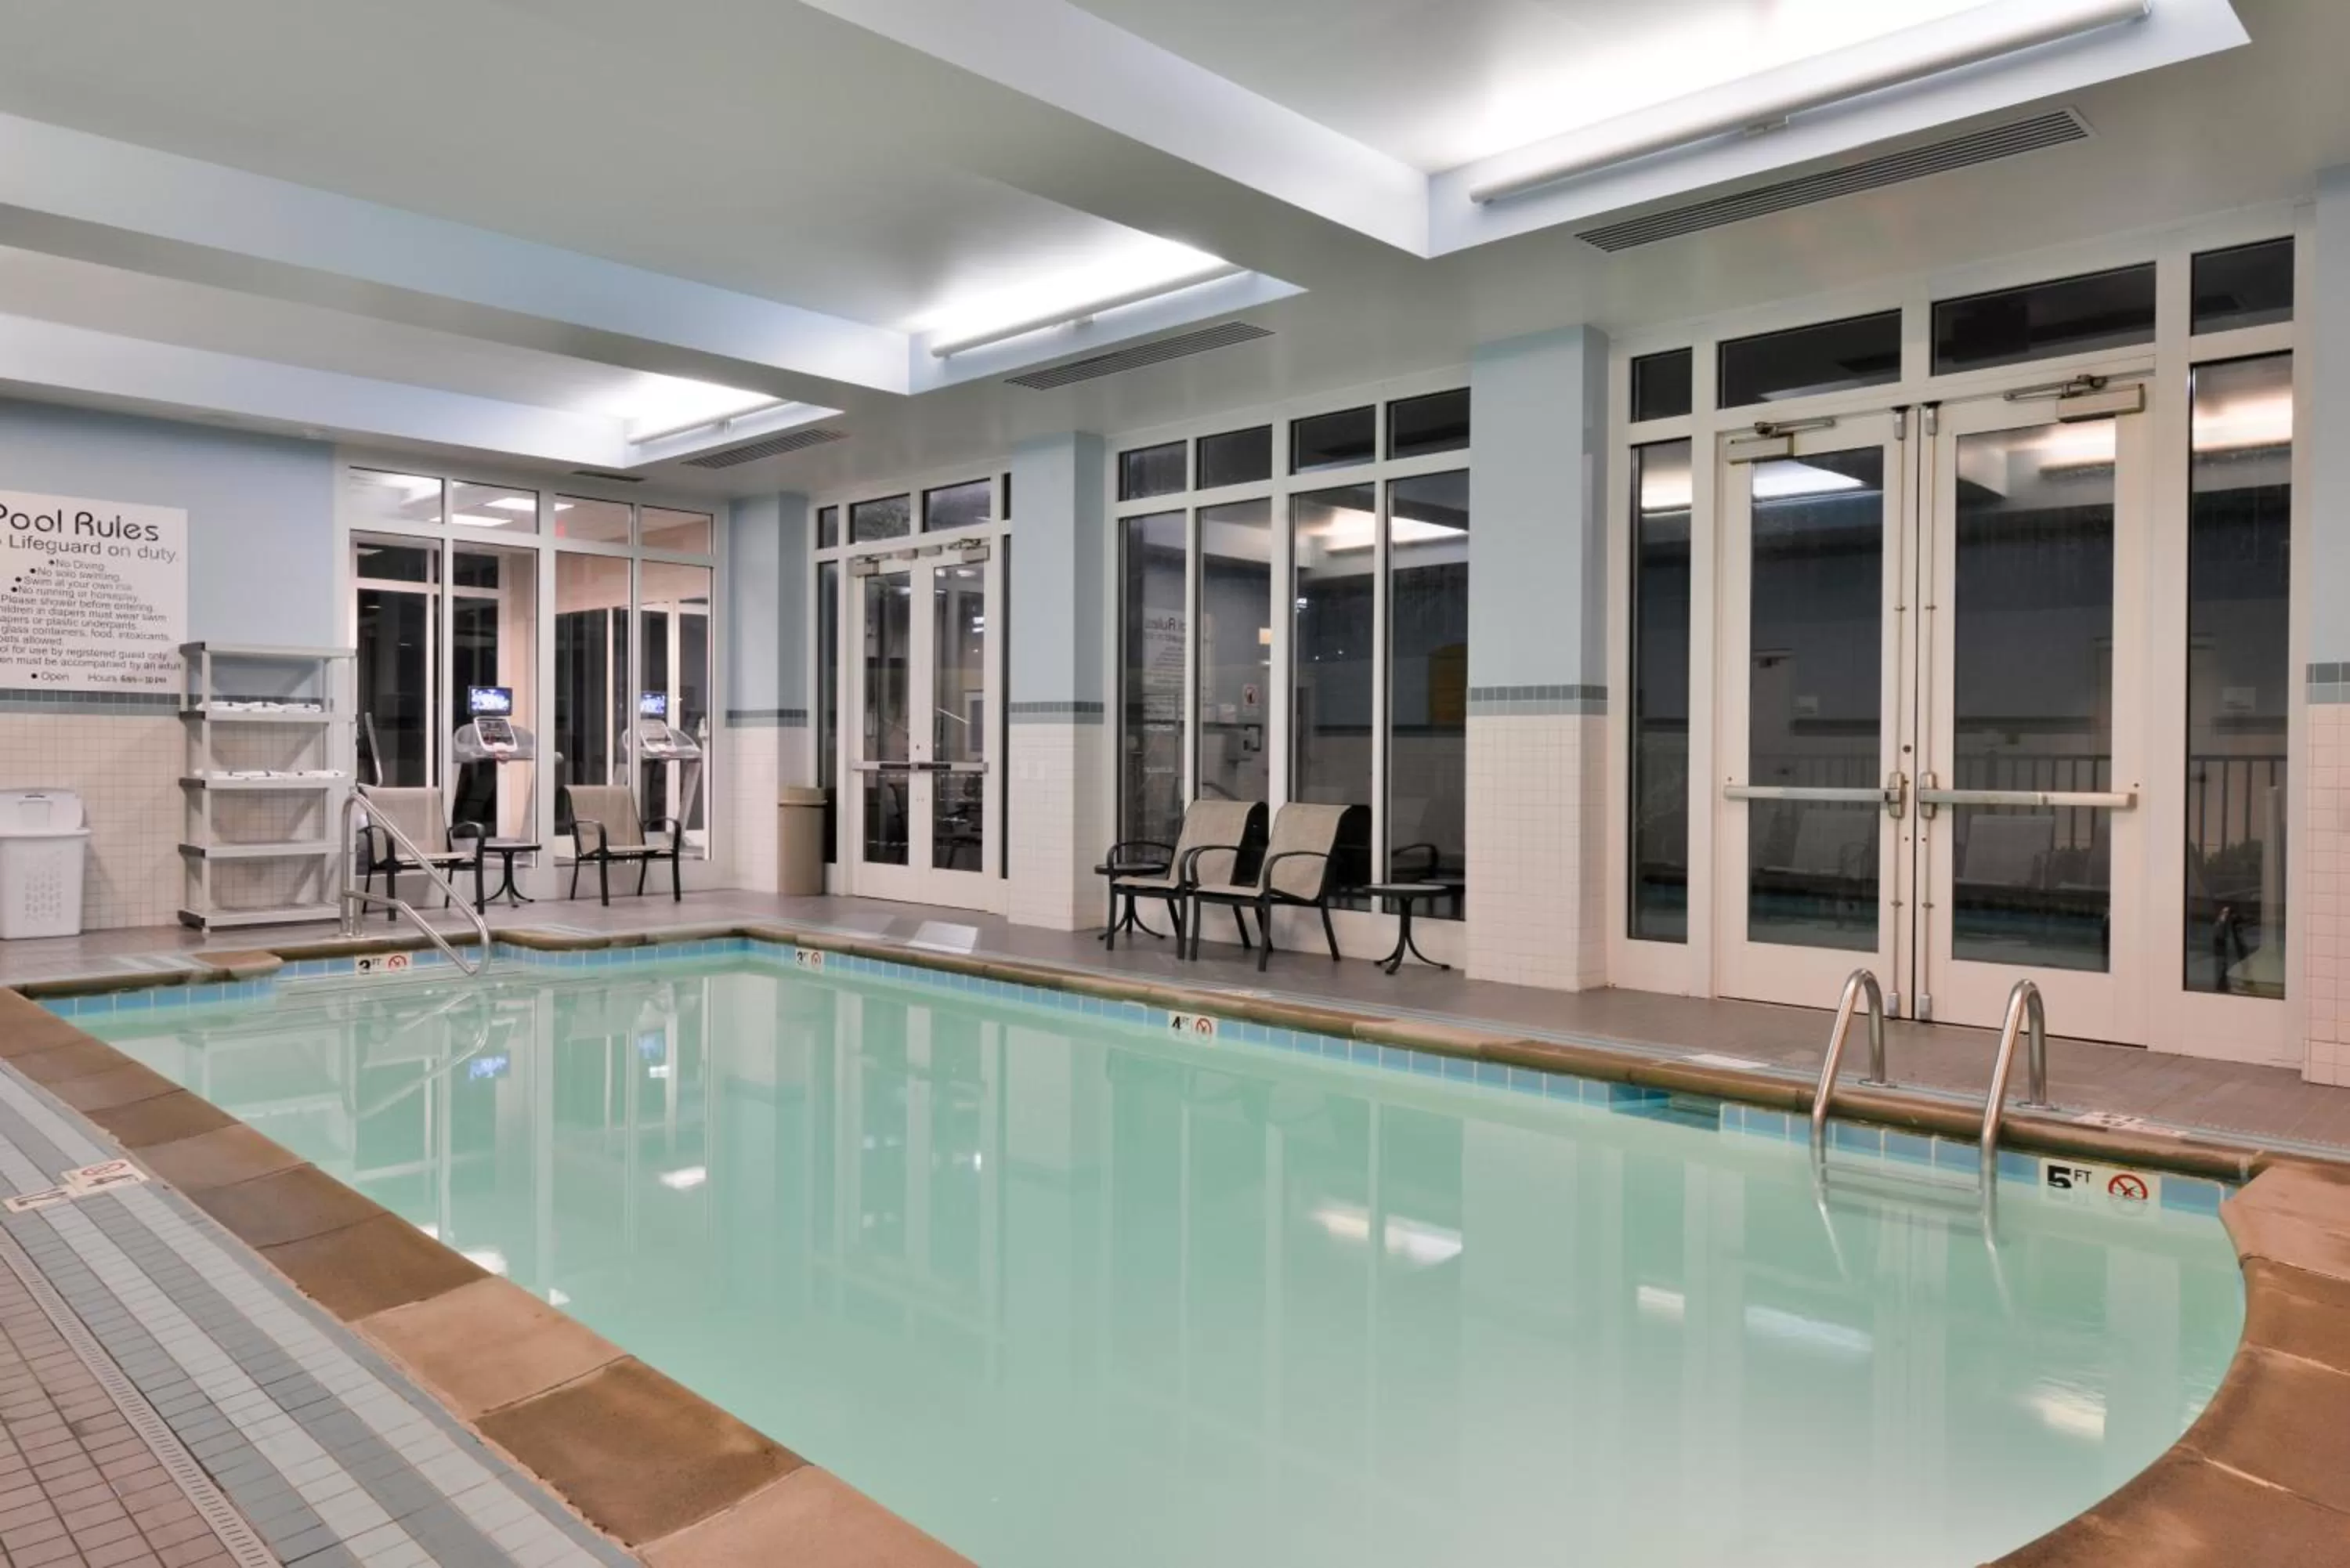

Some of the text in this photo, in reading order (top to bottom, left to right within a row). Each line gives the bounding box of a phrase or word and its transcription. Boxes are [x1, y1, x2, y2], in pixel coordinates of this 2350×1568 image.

[74, 511, 159, 541] Rules
[9, 534, 101, 555] Lifeguard
[107, 545, 131, 558] on
[37, 566, 52, 577] No
[24, 576, 52, 587] Swim
[67, 580, 89, 590] your
[18, 585, 34, 594] No
[36, 588, 74, 599] running
[1, 594, 37, 605] Please
[41, 671, 70, 682] Open
[87, 674, 118, 683] Hours
[2048, 1165, 2093, 1189] 5 FT
